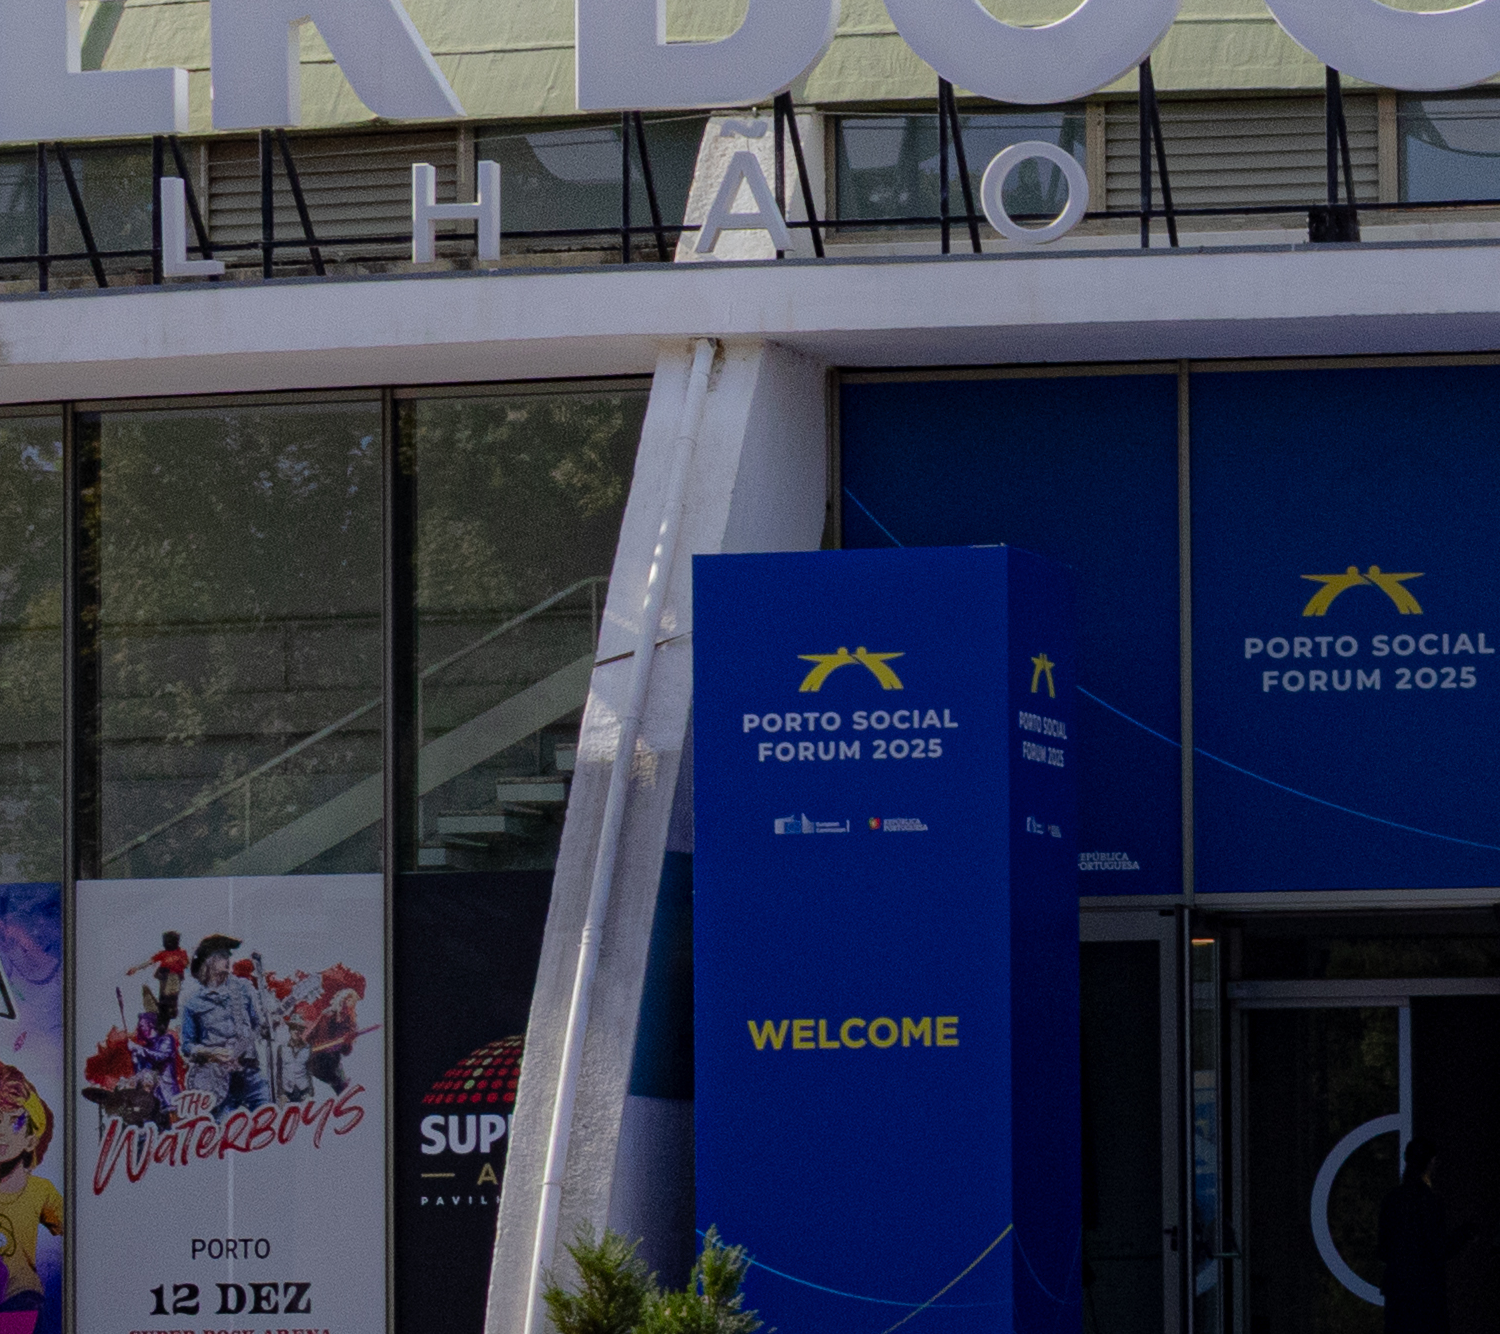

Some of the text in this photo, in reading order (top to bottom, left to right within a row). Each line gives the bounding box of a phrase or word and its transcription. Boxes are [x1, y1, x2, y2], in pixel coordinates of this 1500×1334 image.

[1245, 633, 1495, 660] PORTO SOCIAL
[1262, 666, 1477, 692] FORUM 2025
[743, 709, 959, 733] PORTO SOCIAL
[758, 738, 943, 762] FORUM 2025
[1078, 850, 1130, 861] EPÚBLICA
[1078, 860, 1141, 871] ORTUGUESA
[747, 1015, 960, 1051] WELCOME
[420, 1113, 514, 1155] SUP
[191, 1238, 271, 1260] PORTO
[150, 1282, 312, 1315] 12 DEZ
